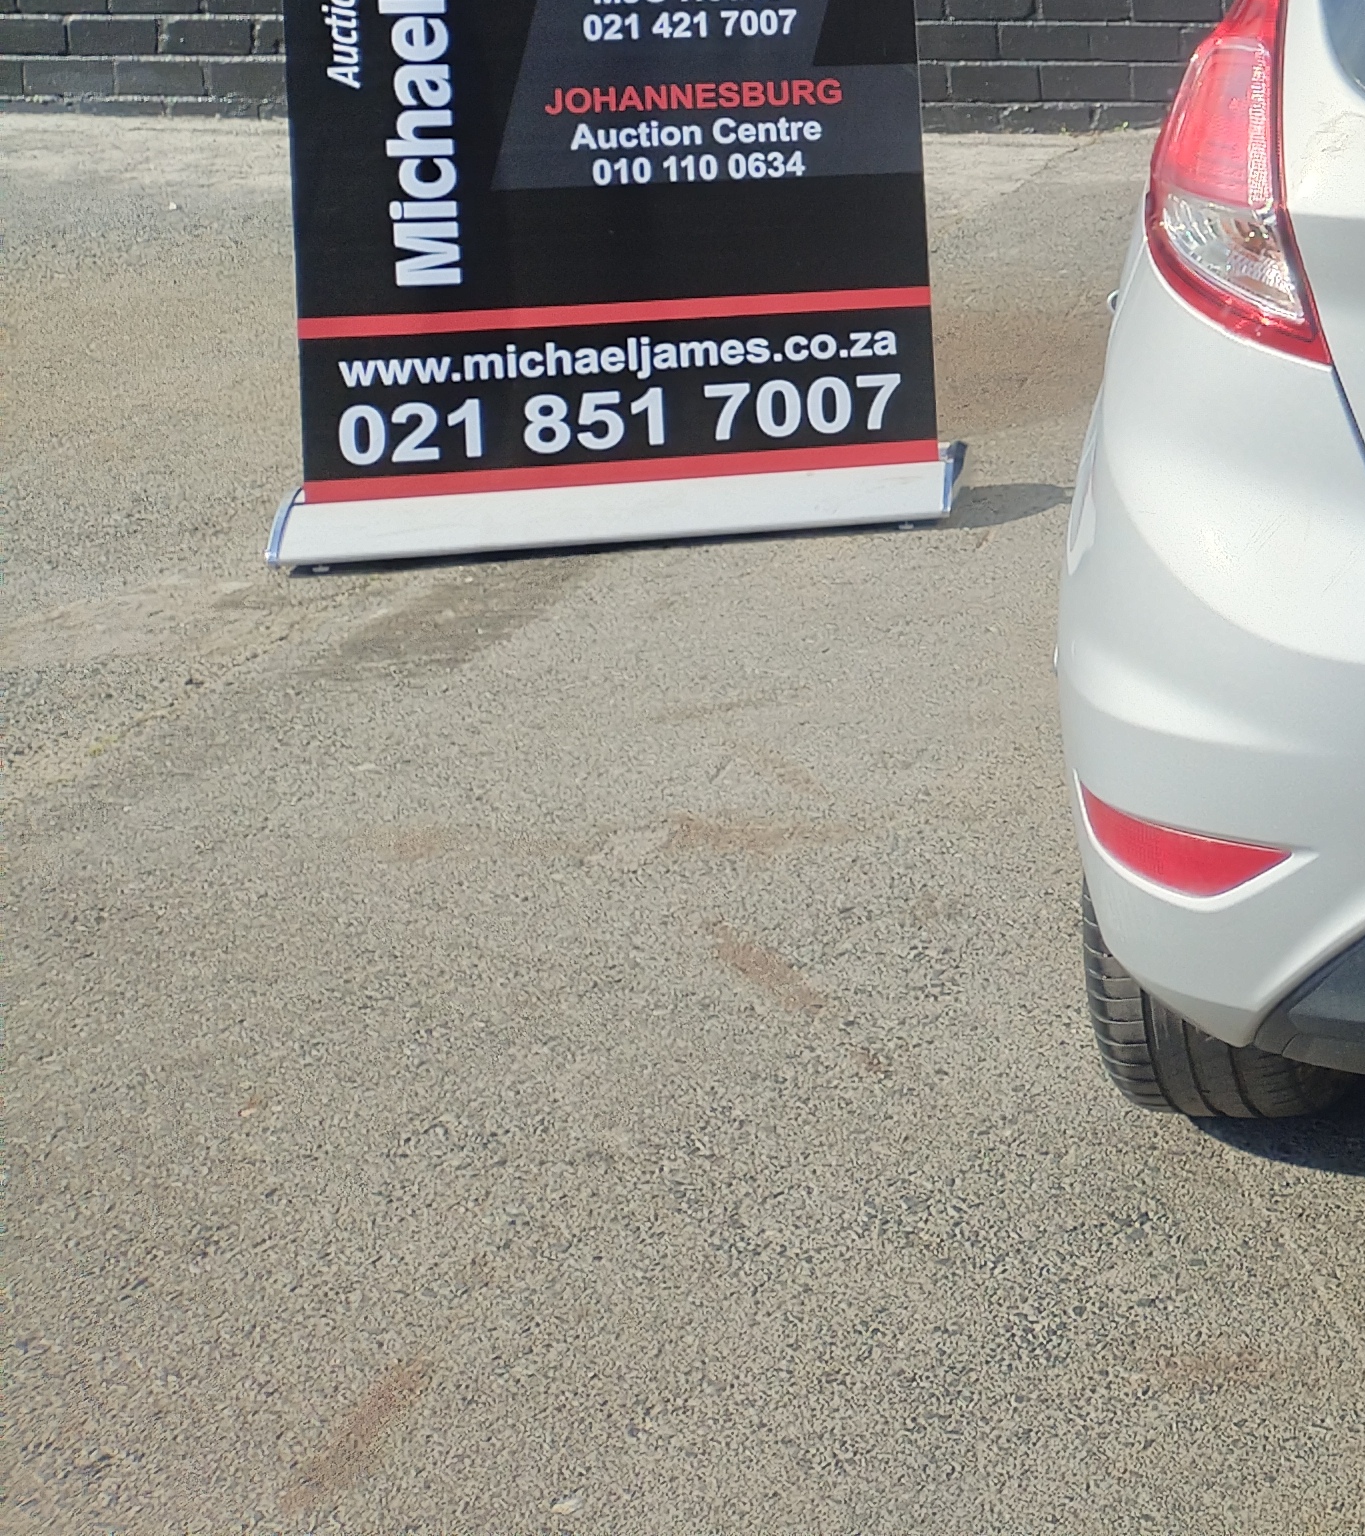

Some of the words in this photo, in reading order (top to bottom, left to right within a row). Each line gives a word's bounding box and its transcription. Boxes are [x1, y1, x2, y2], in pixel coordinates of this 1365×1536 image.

[583, 13, 639, 42] 021
[651, 10, 708, 39] 421
[720, 8, 797, 37] 7007
[545, 78, 843, 115] JOHANNESBURG
[570, 120, 703, 151] Auction
[712, 116, 822, 144] Centre
[592, 156, 652, 186] 010
[662, 153, 719, 182] 110
[727, 150, 806, 180] 0634
[337, 329, 898, 381] www.michaeljames.co.za
[338, 398, 482, 466] 021
[523, 387, 665, 454] 851
[703, 373, 901, 441] 7007
